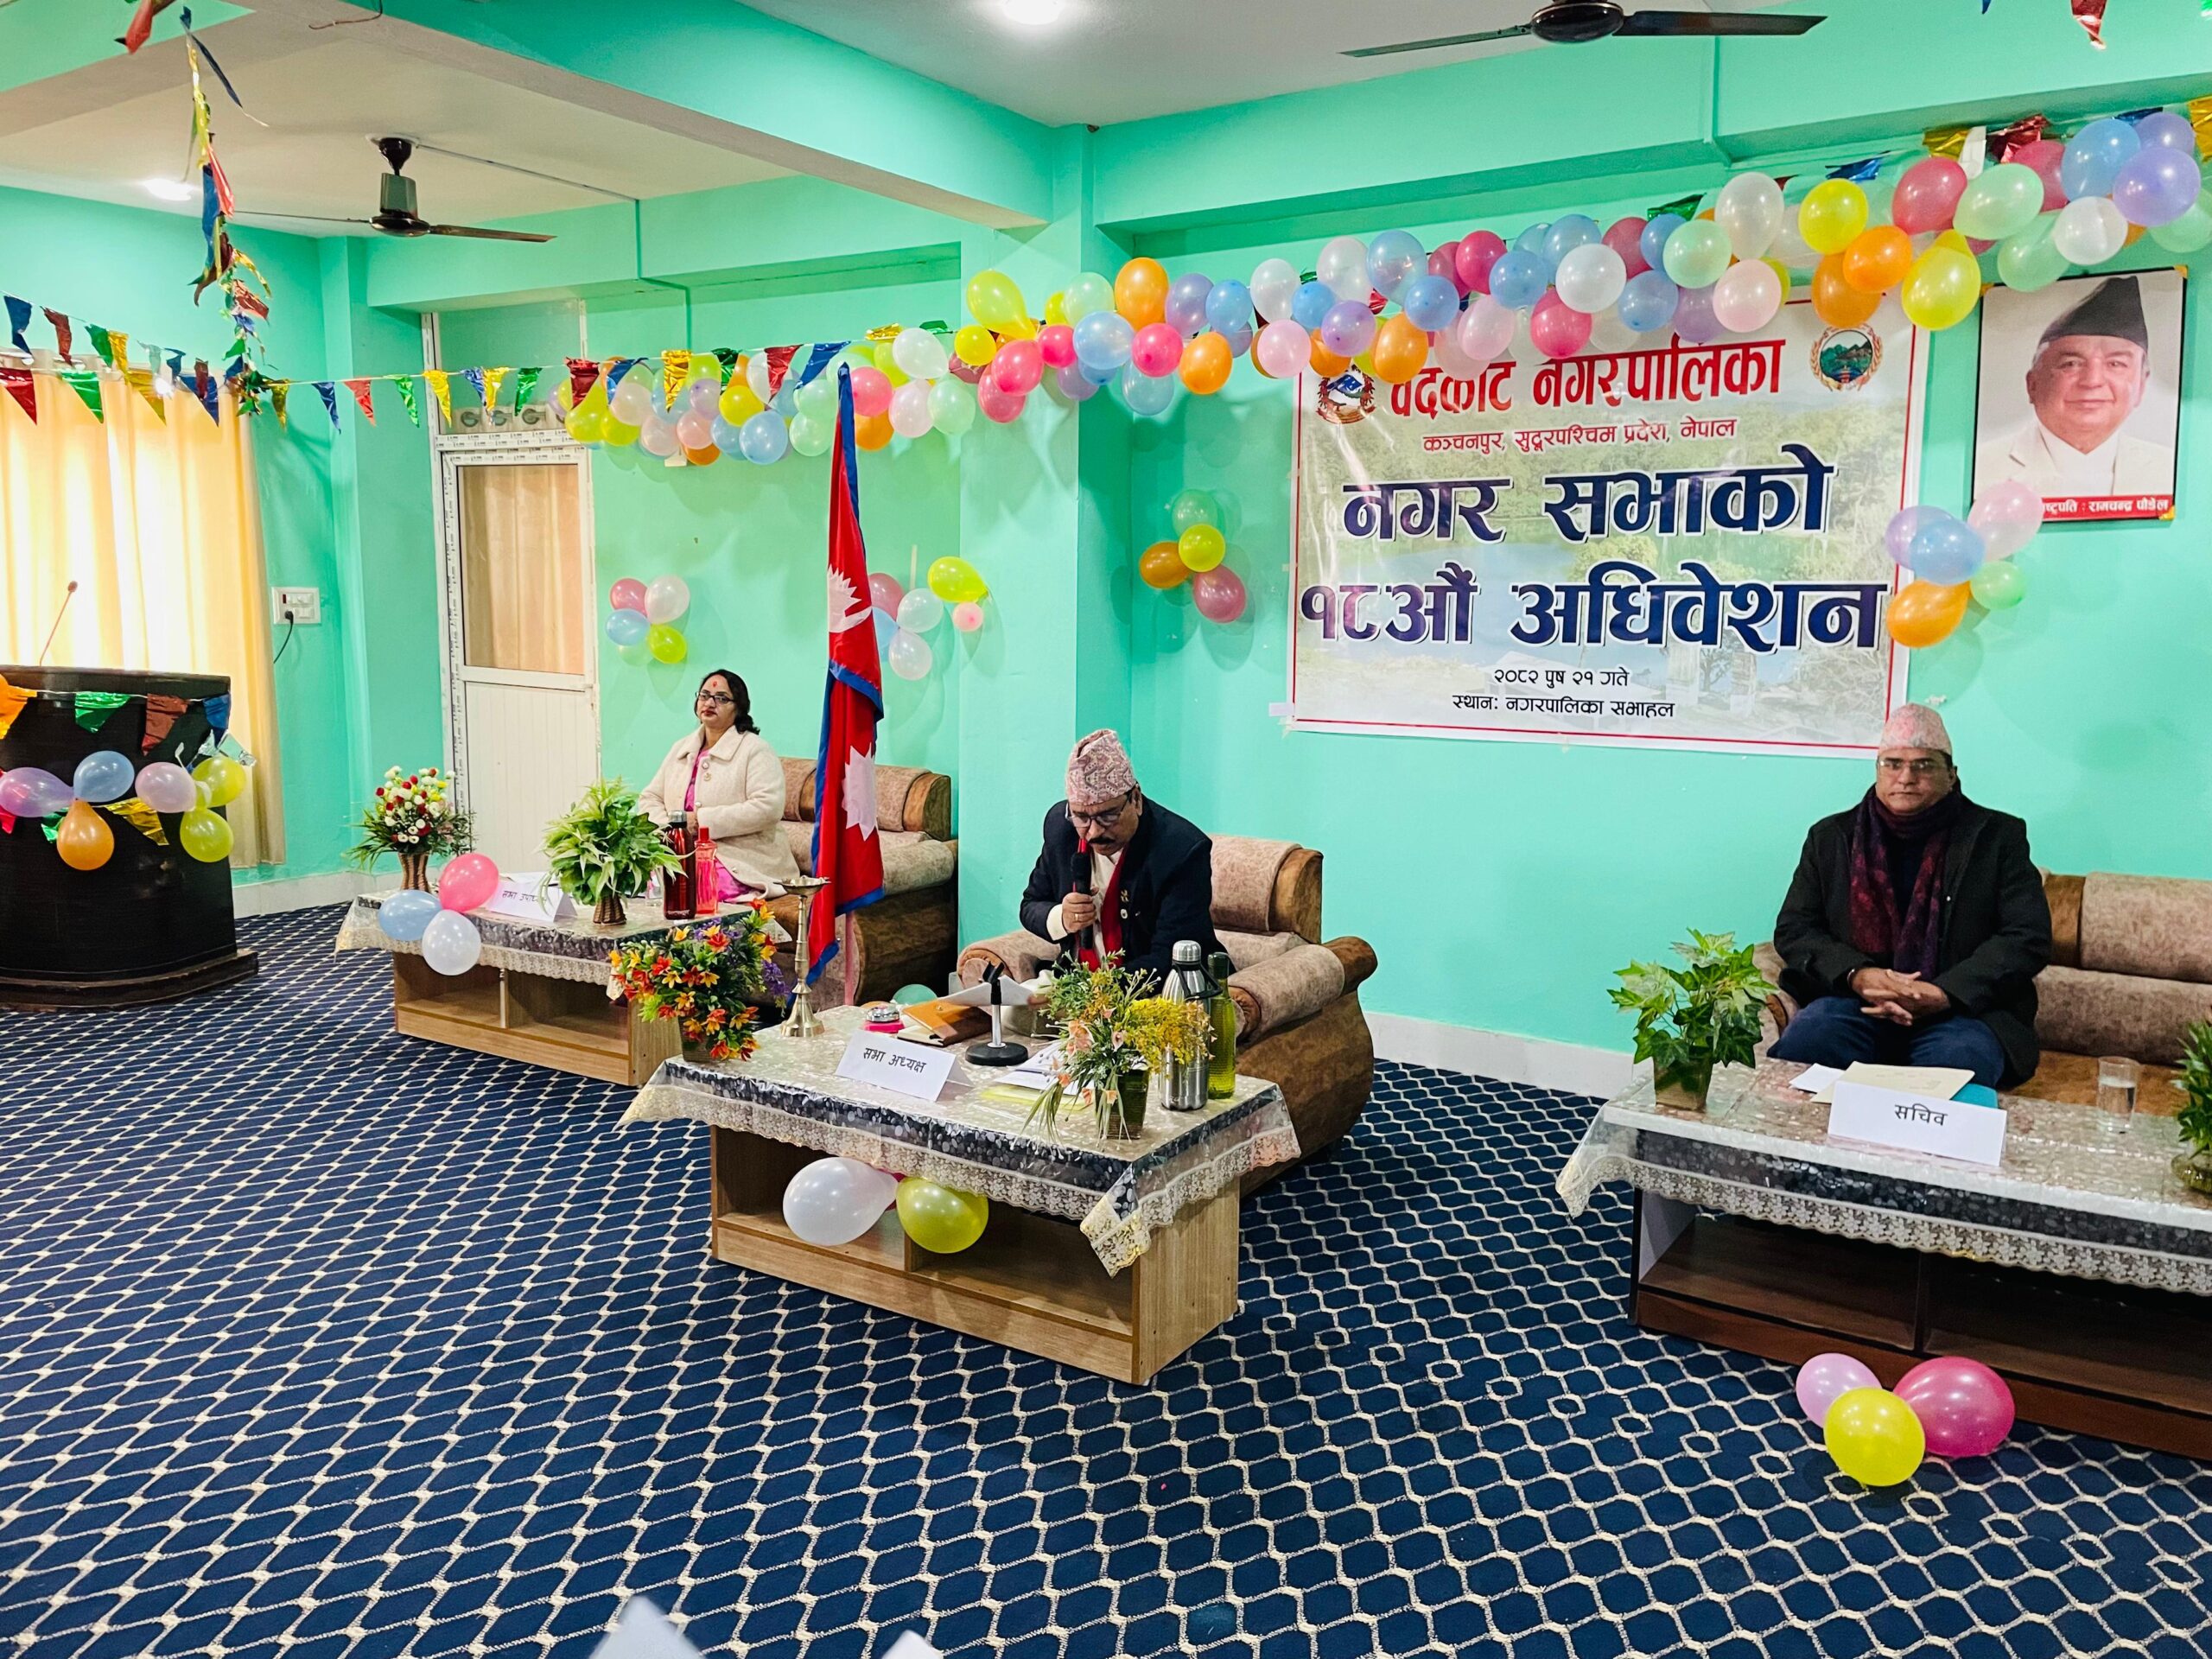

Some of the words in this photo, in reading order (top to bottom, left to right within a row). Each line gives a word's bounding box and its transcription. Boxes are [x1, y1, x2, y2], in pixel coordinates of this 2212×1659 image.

[1533, 332, 1786, 407] नगरपालिका
[1680, 416, 1738, 438] नेपाल
[1343, 477, 1512, 542] नगर
[1543, 443, 1835, 543] सभाको
[1510, 562, 1888, 652] अधिवेशन
[1494, 669, 1539, 684] २०८२
[1545, 670, 1566, 689] पुष
[1573, 670, 1593, 685] २१
[1599, 666, 1630, 686] गते
[1505, 696, 1605, 715] नगरपालिका
[1611, 700, 1675, 717] सभाहल
[863, 1047, 887, 1063] सभा
[888, 1054, 927, 1073] अध्यक्ष
[1894, 1103, 1948, 1126] सचिव
